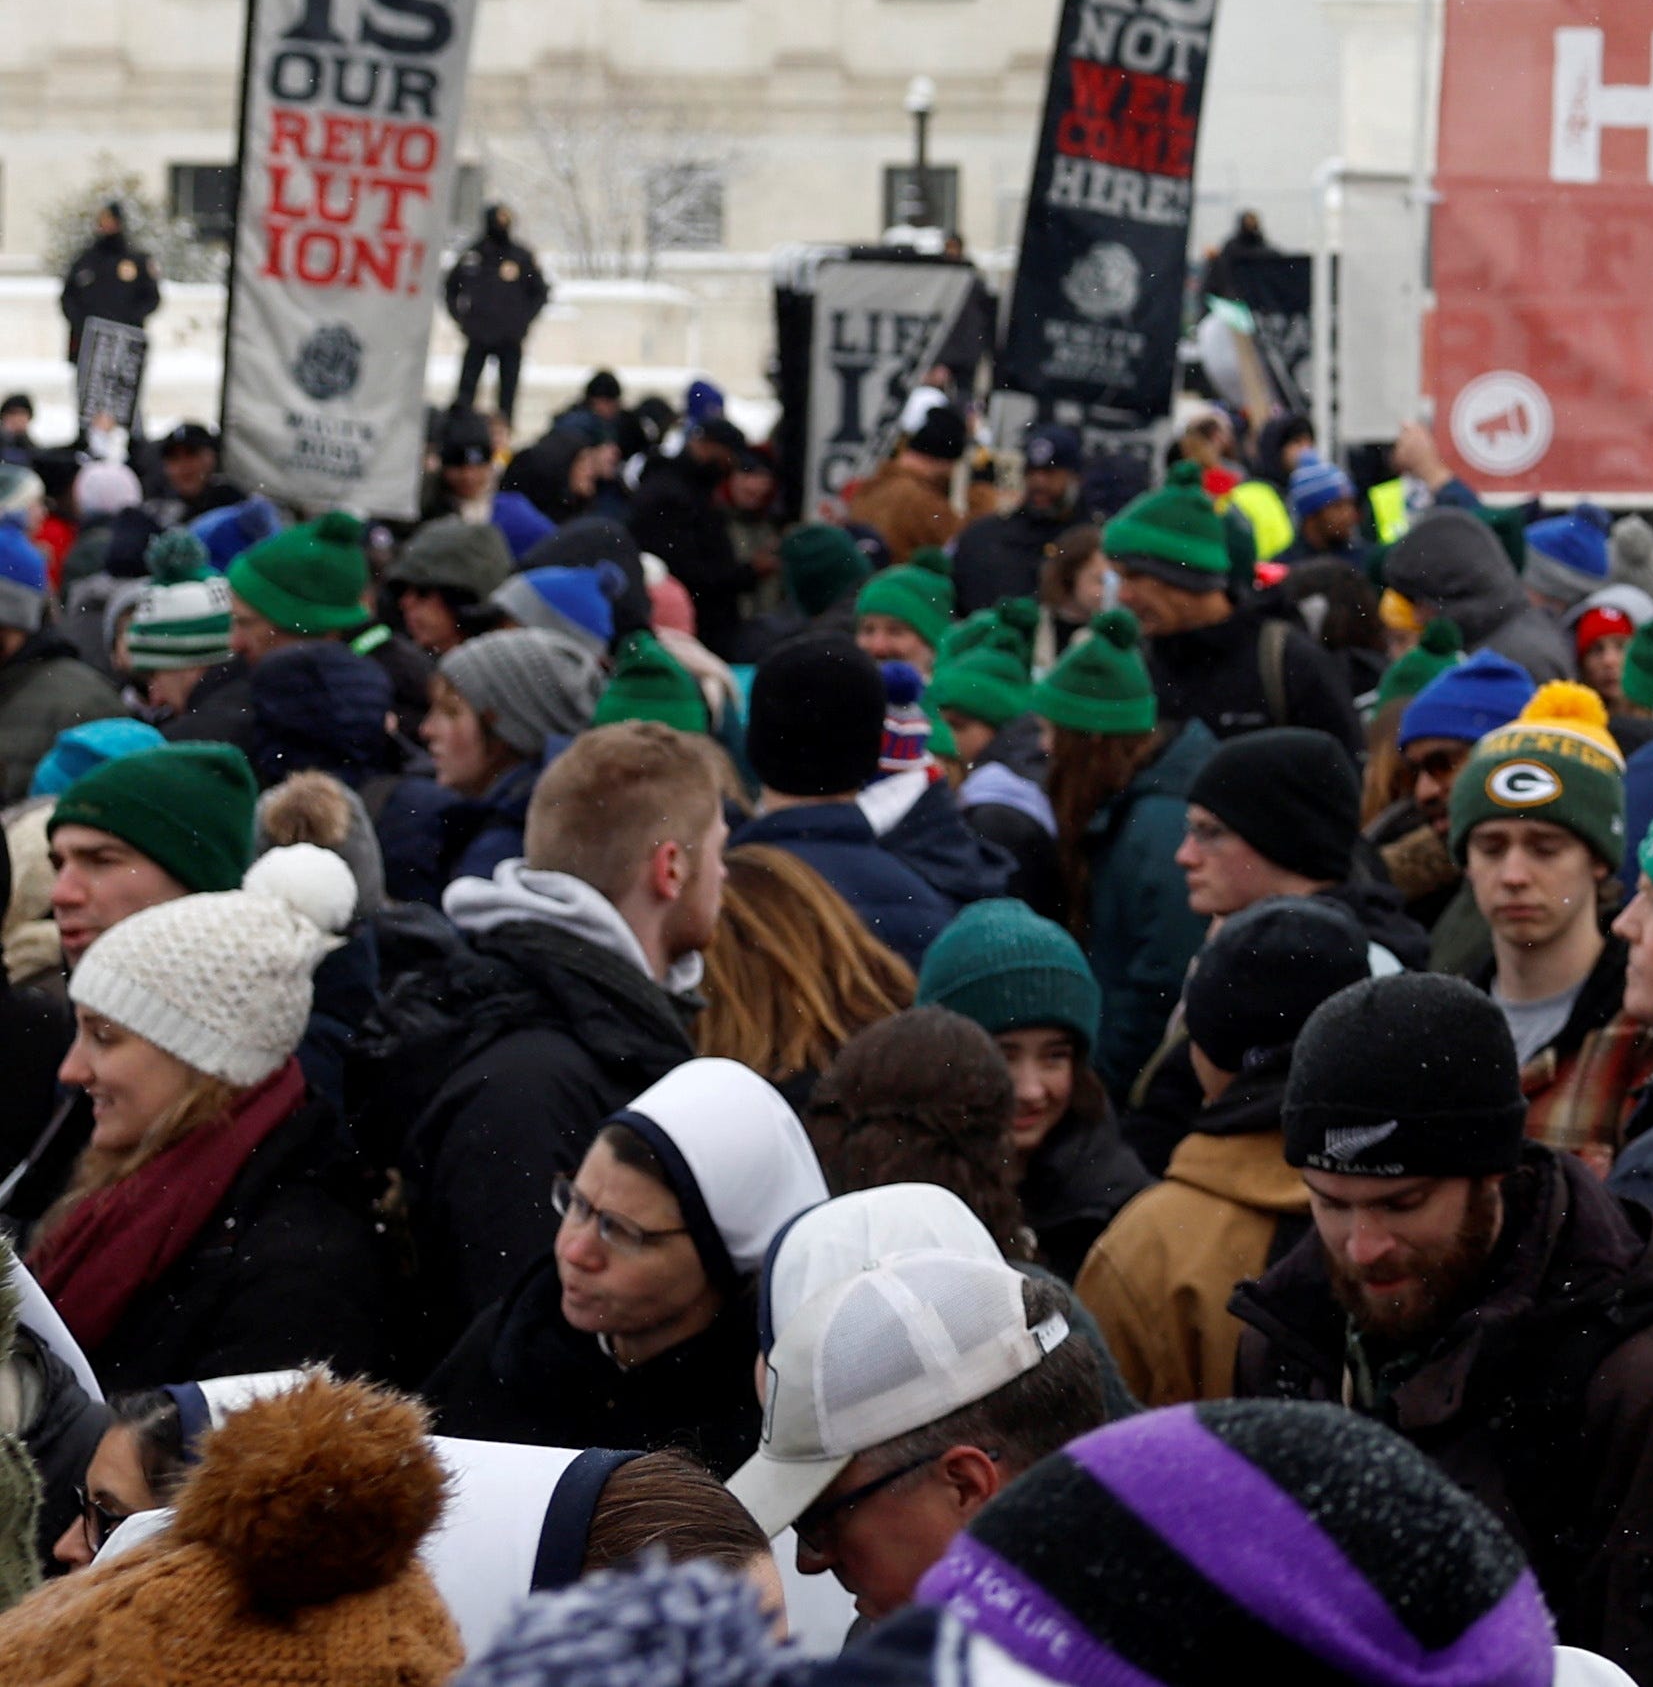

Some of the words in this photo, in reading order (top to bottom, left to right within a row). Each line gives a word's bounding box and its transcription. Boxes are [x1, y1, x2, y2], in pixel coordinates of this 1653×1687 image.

[1069, 9, 1208, 82] NOT
[269, 51, 438, 117] OUR
[269, 107, 439, 175] REVO
[266, 165, 430, 235] LUT
[260, 220, 428, 296] ION!
